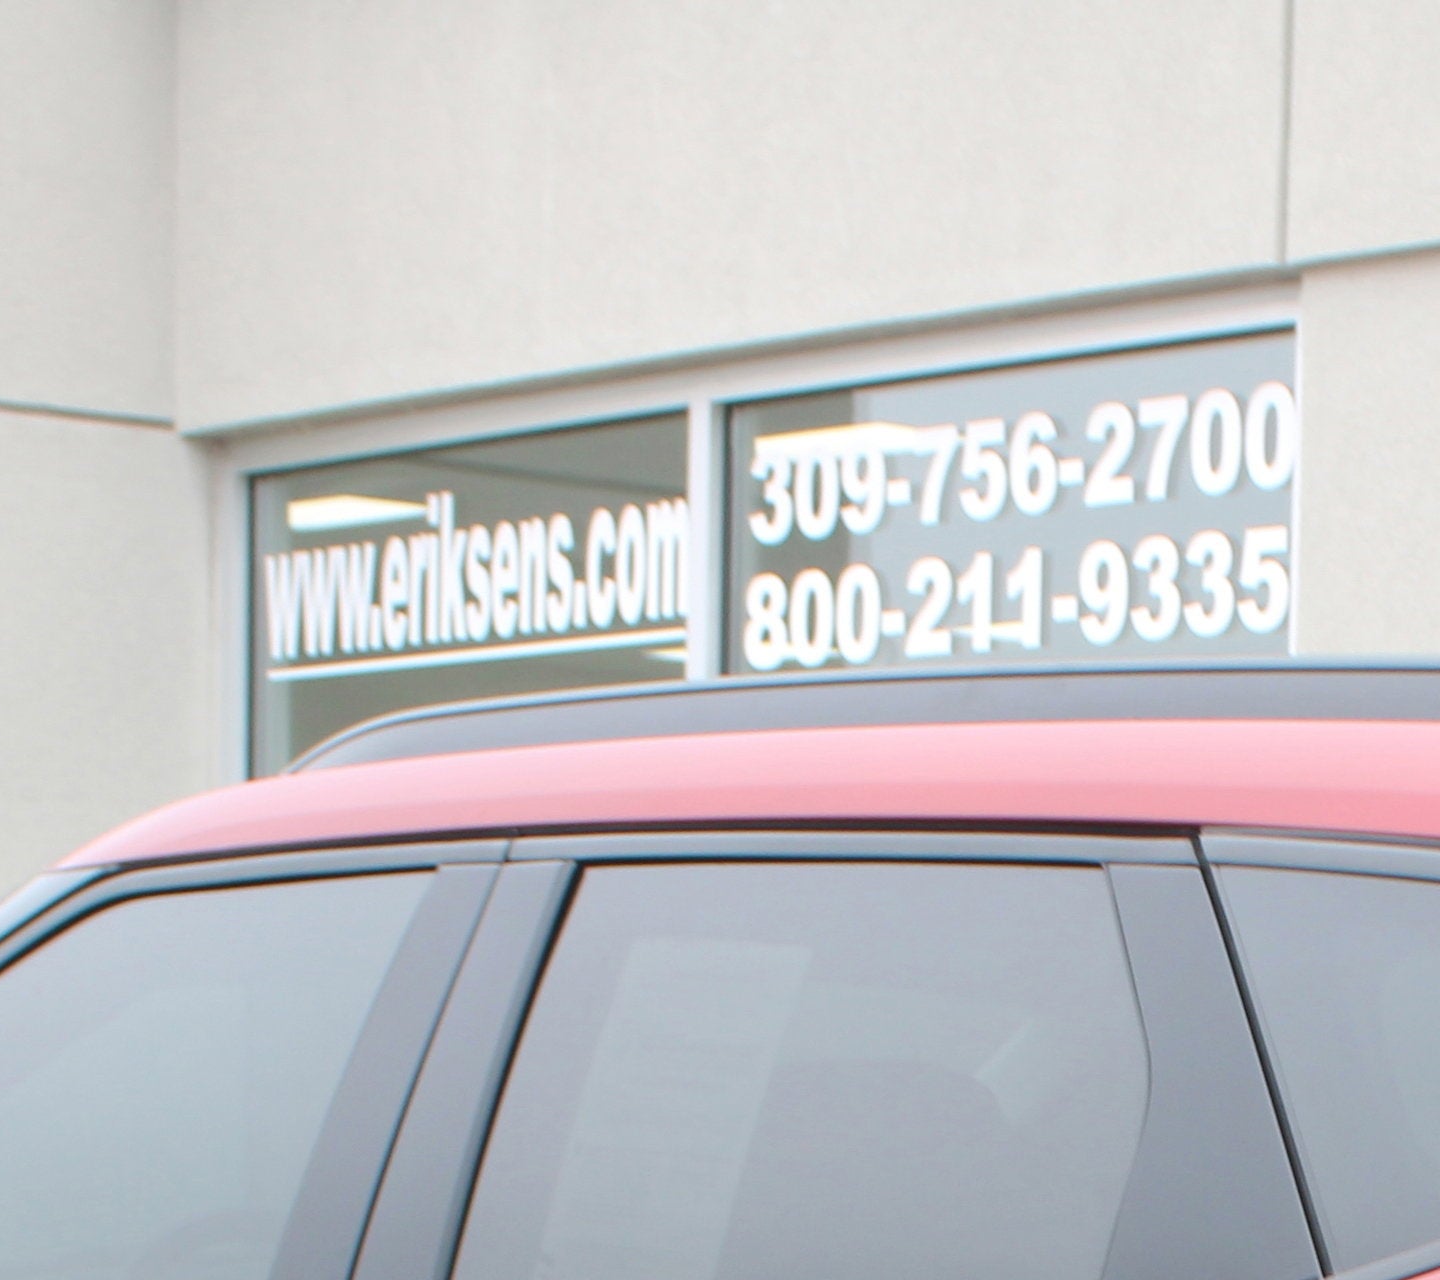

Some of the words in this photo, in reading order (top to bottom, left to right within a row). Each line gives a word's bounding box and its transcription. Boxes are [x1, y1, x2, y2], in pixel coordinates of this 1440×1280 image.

[747, 380, 1296, 548] 309-756-2700
[263, 490, 690, 662] www.eriksens.com
[743, 525, 1291, 671] 800-211-9335
